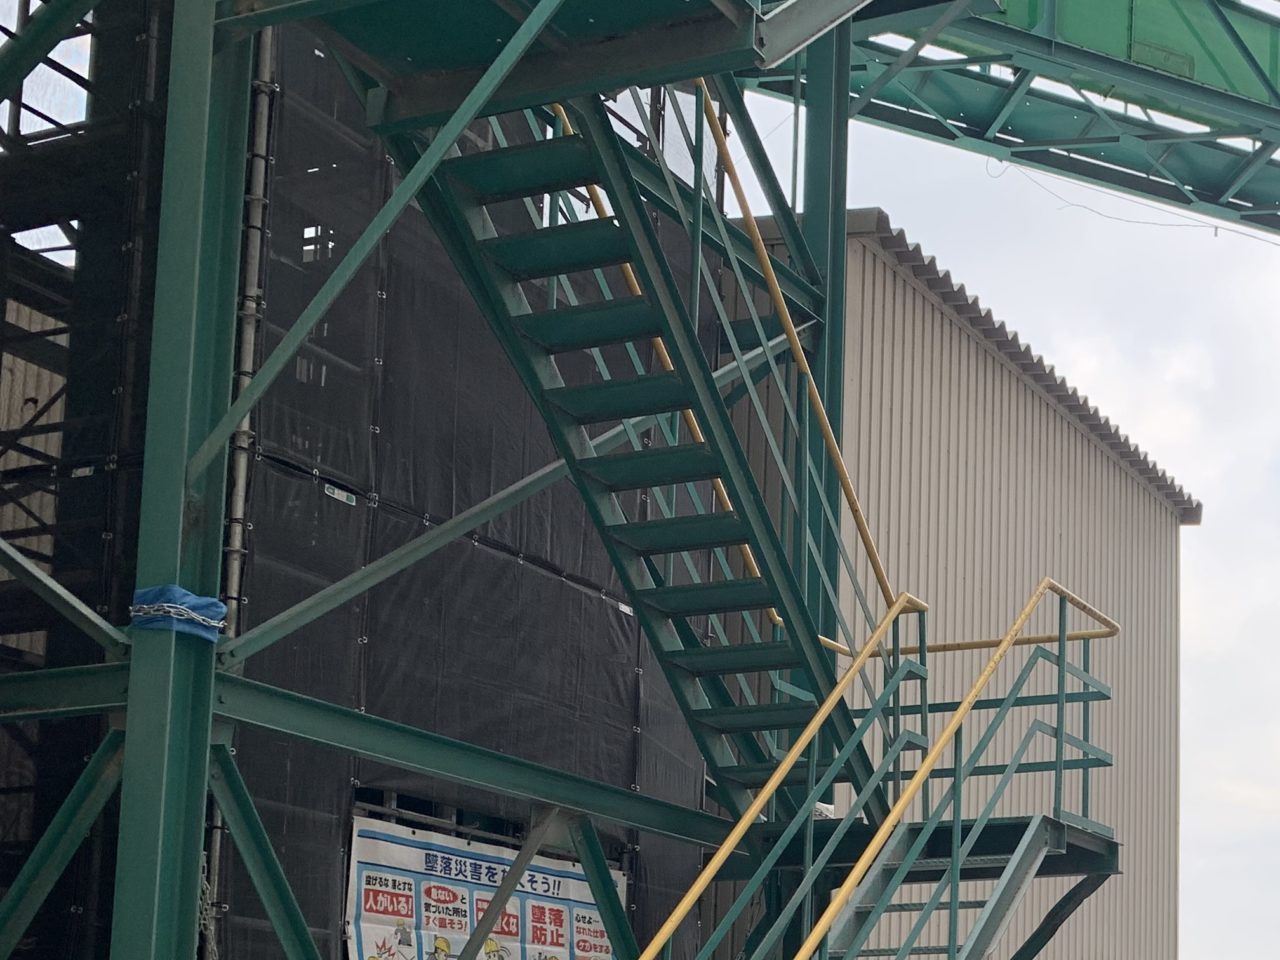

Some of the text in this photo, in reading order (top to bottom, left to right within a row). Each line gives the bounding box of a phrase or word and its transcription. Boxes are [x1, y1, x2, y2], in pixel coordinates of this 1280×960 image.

[366, 891, 412, 916] 人がいる!
[424, 902, 467, 918] 気づいた所は
[531, 904, 564, 928] 墜落
[531, 924, 565, 948] 防止
